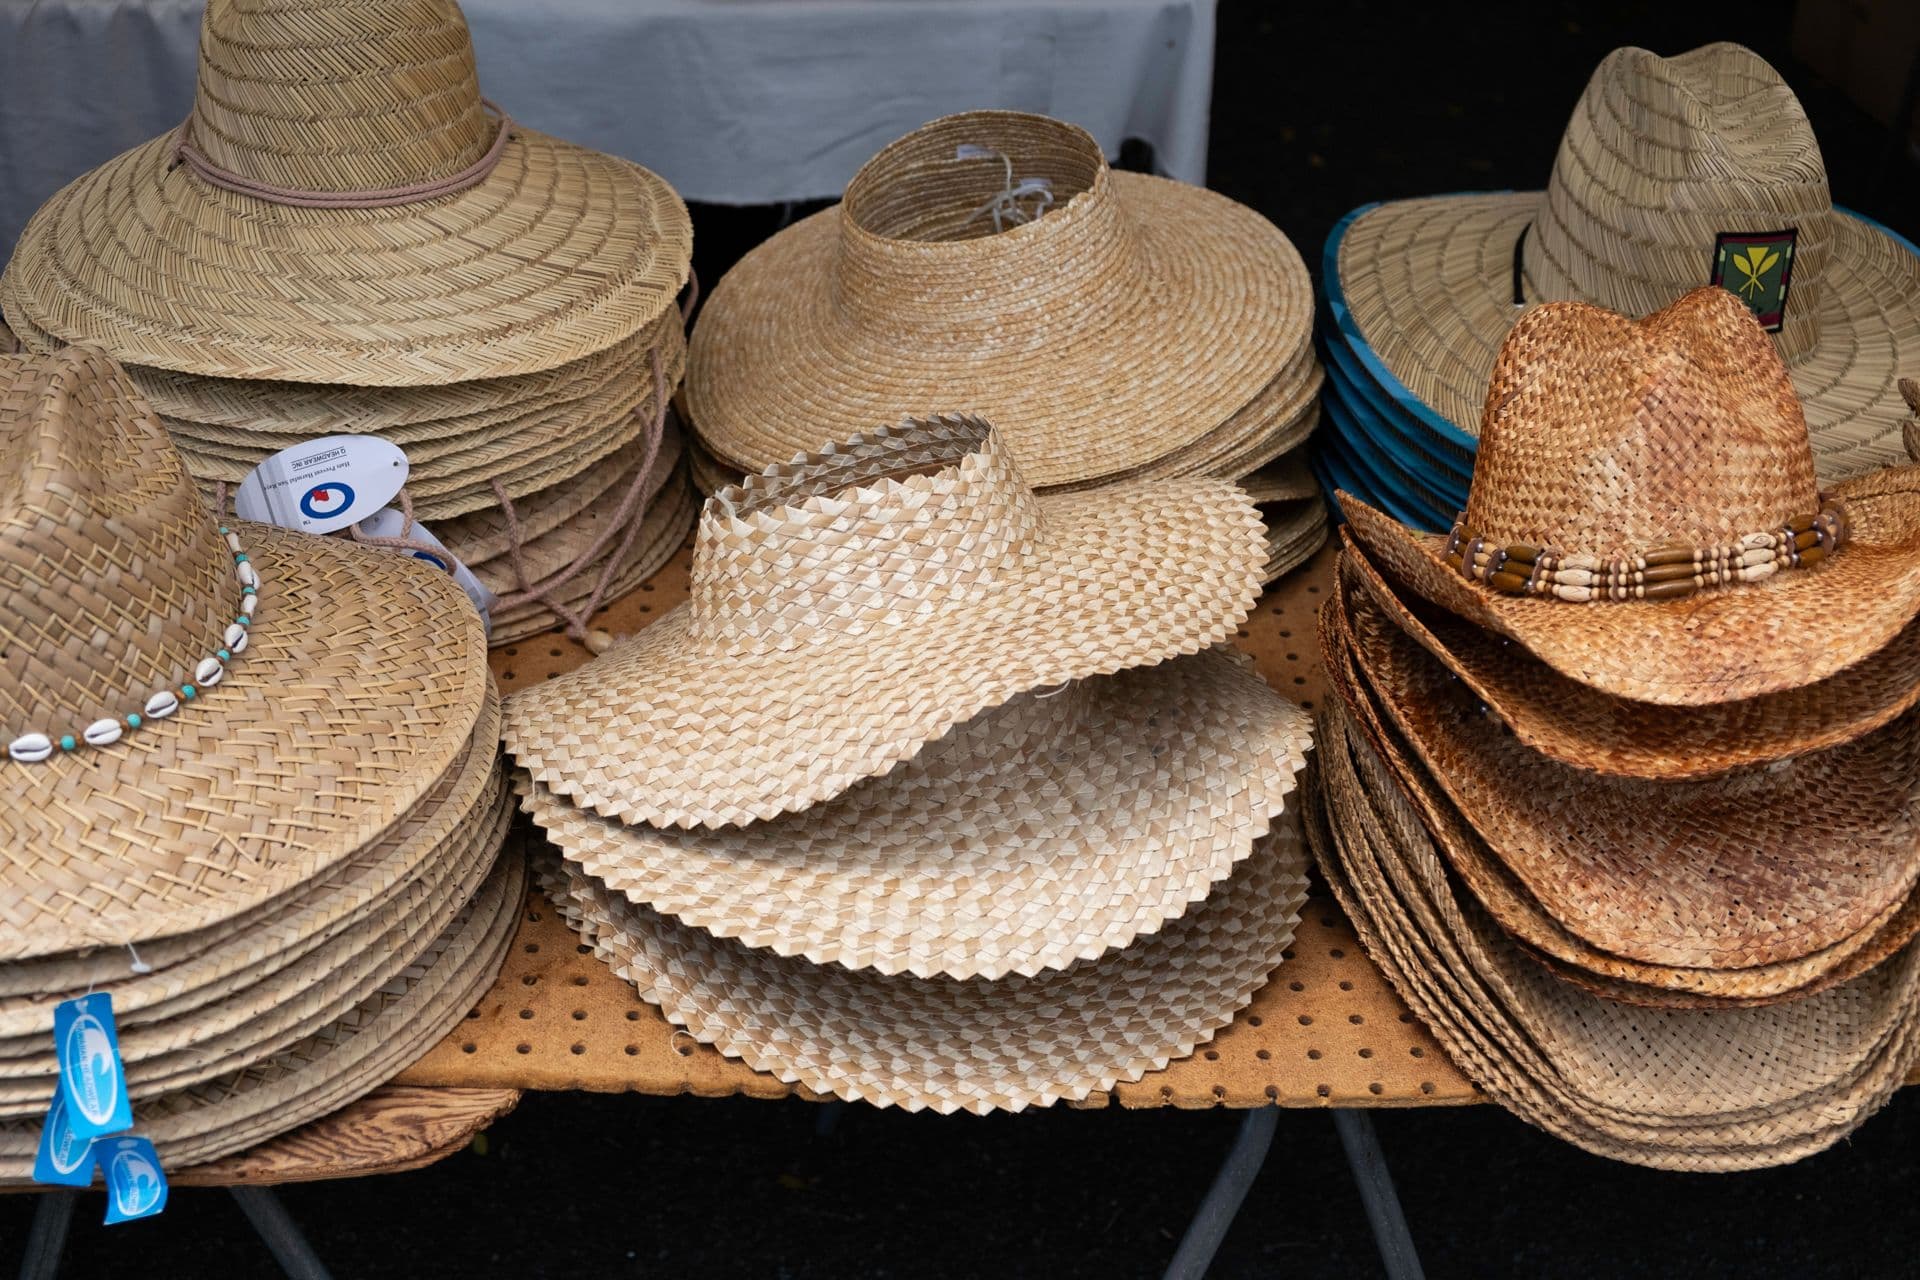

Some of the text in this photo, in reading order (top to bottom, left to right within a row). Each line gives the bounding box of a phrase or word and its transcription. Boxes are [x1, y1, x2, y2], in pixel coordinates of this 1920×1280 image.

[304, 449, 340, 465] HEADWEAR
[292, 460, 303, 469] INC
[336, 461, 350, 469] Hats
[314, 466, 336, 476] Prevent
[290, 472, 314, 484] Harmful
